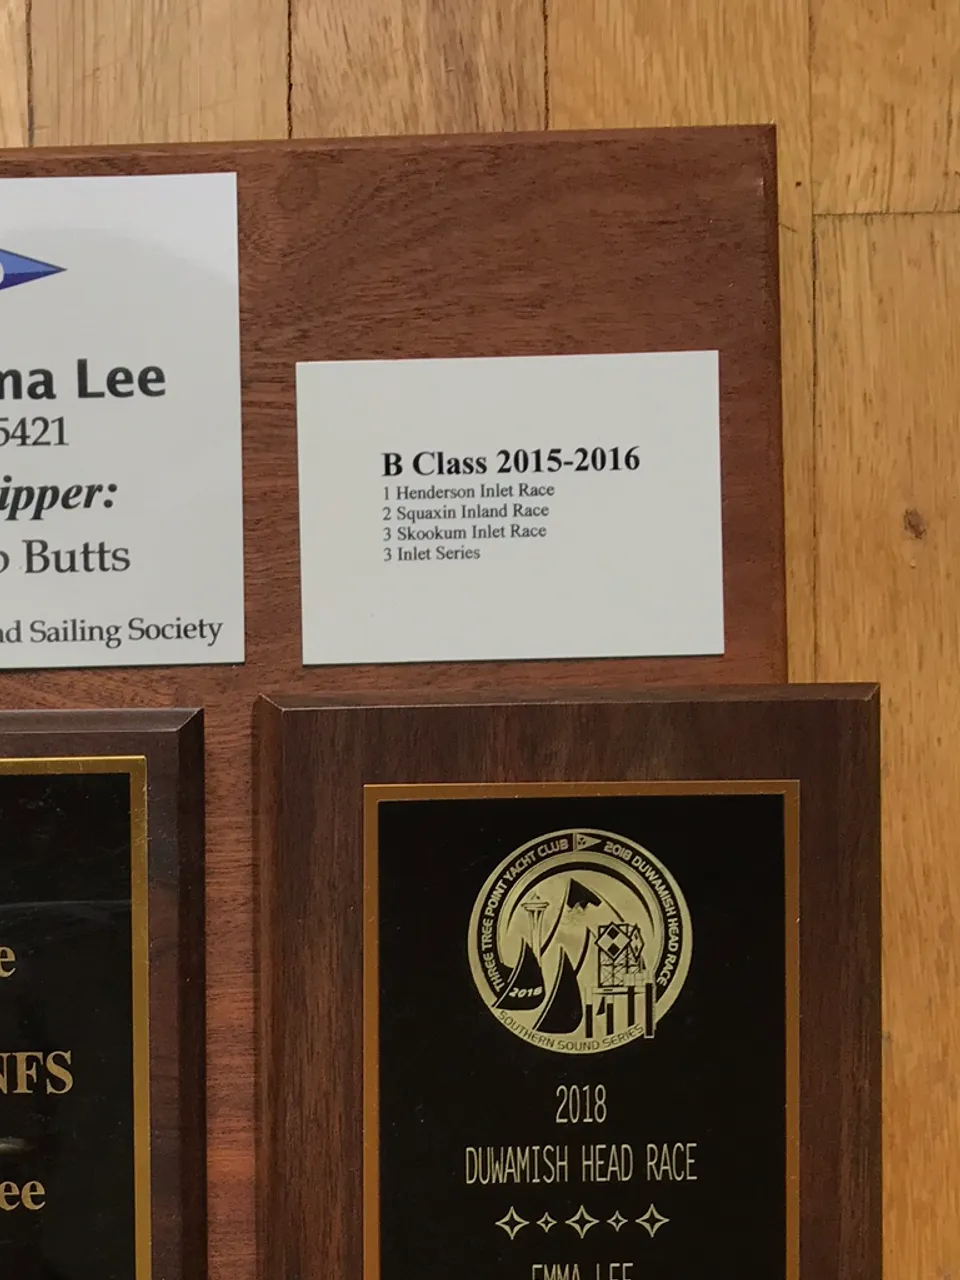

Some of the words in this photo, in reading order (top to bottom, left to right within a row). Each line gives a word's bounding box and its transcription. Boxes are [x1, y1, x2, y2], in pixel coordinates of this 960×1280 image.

[78, 359, 165, 398] Lee
[384, 453, 402, 476] B
[413, 452, 487, 475] Class
[498, 447, 639, 473] 2015-2016
[385, 487, 389, 500] 1
[397, 485, 474, 500] Henderson
[481, 483, 513, 497] Inlet
[519, 483, 554, 496] Race
[383, 507, 391, 520] 2
[397, 505, 456, 523] Squaxin
[462, 504, 507, 518] Inland
[513, 504, 548, 517] Race
[384, 527, 391, 541] 3
[398, 526, 466, 540] Skookum
[473, 524, 505, 538] Inlet
[511, 524, 546, 537] Race
[23, 540, 130, 573] Butts
[384, 548, 392, 561] 3
[399, 547, 431, 560] Inlet
[436, 545, 480, 559] Series
[30, 619, 121, 648] Sailing
[128, 617, 222, 646] Society
[538, 838, 569, 857] CLUB
[605, 842, 632, 861] 2018
[505, 852, 537, 881] YACHT
[487, 879, 508, 916] POINT
[633, 858, 675, 917] DUWAMISH
[481, 918, 493, 950] TREE
[668, 919, 680, 952] HEAD
[482, 952, 504, 992] THREE
[658, 953, 676, 987] RACE
[498, 1010, 555, 1048] SOUTHERN
[558, 1040, 600, 1051] SOUND
[602, 1024, 644, 1046] SERIES
[556, 1085, 606, 1123] 2018
[466, 1145, 567, 1184] DUWAMISH
[582, 1144, 633, 1181] HEAD
[647, 1143, 697, 1181] RACE
